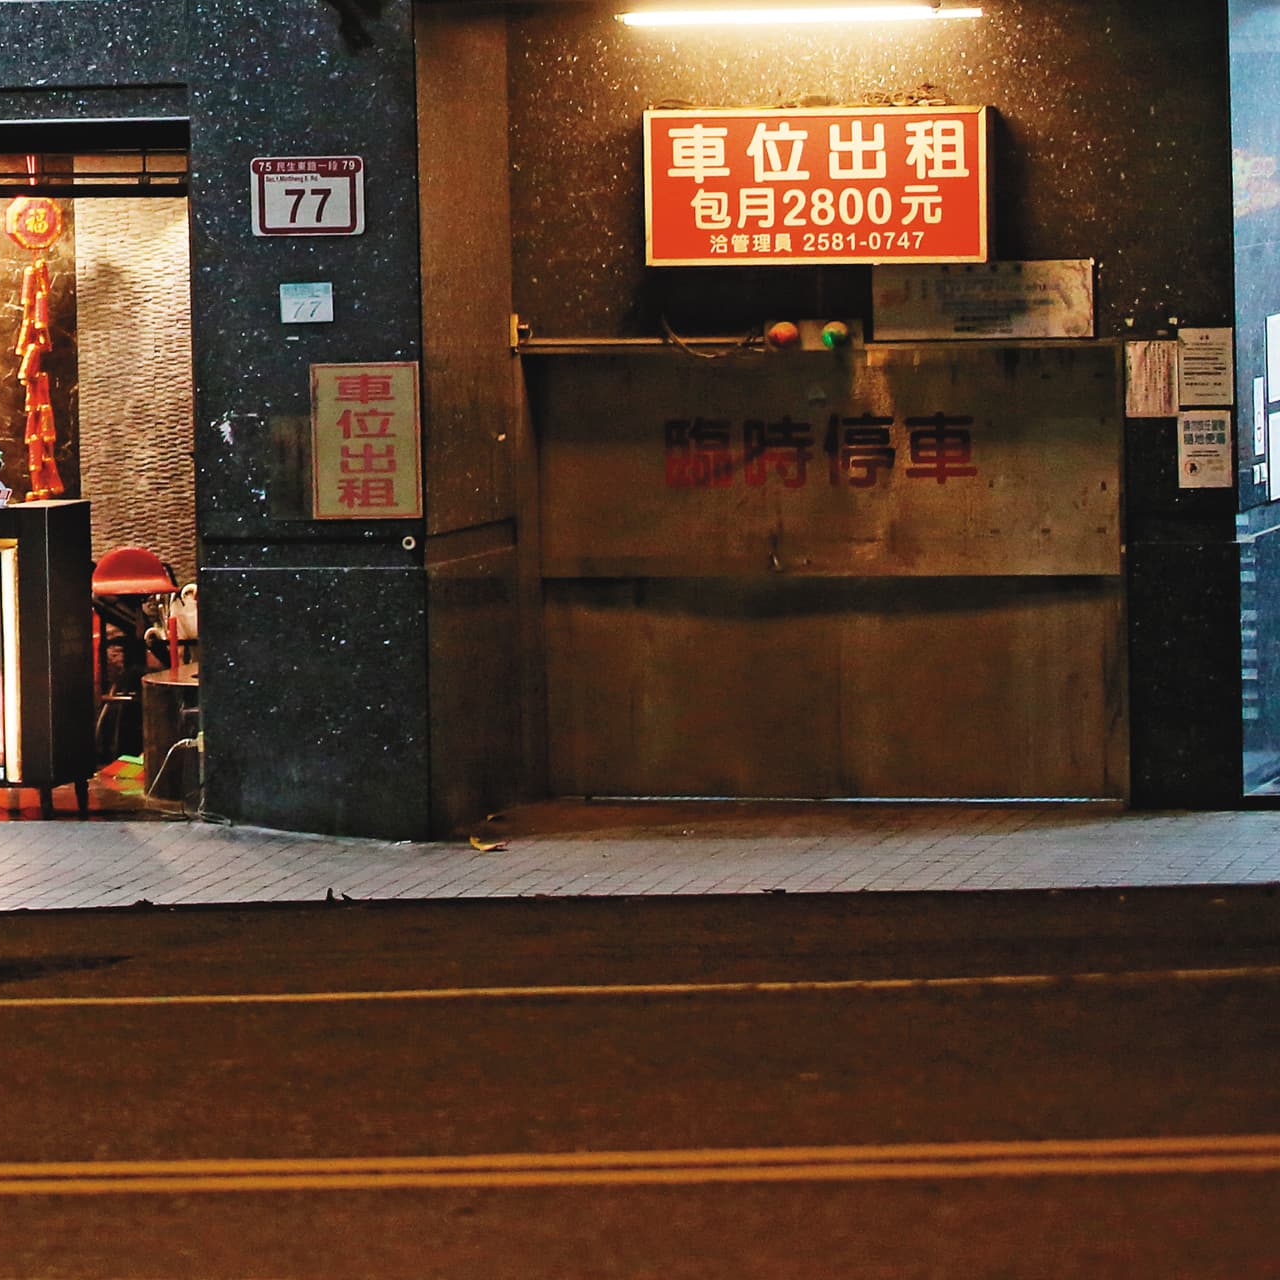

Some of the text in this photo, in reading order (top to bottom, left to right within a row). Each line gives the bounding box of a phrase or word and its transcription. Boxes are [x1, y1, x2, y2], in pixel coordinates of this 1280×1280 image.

[258, 160, 356, 172] 75 民生東路一段 79
[667, 119, 970, 184] 車位出租
[25, 208, 49, 234] 福
[285, 188, 332, 223] 77
[690, 183, 943, 230] 包月2800元
[709, 231, 926, 254] 洽管理員 2581-0747
[335, 374, 399, 508] 車位出租
[663, 411, 978, 489] 臨時停車
